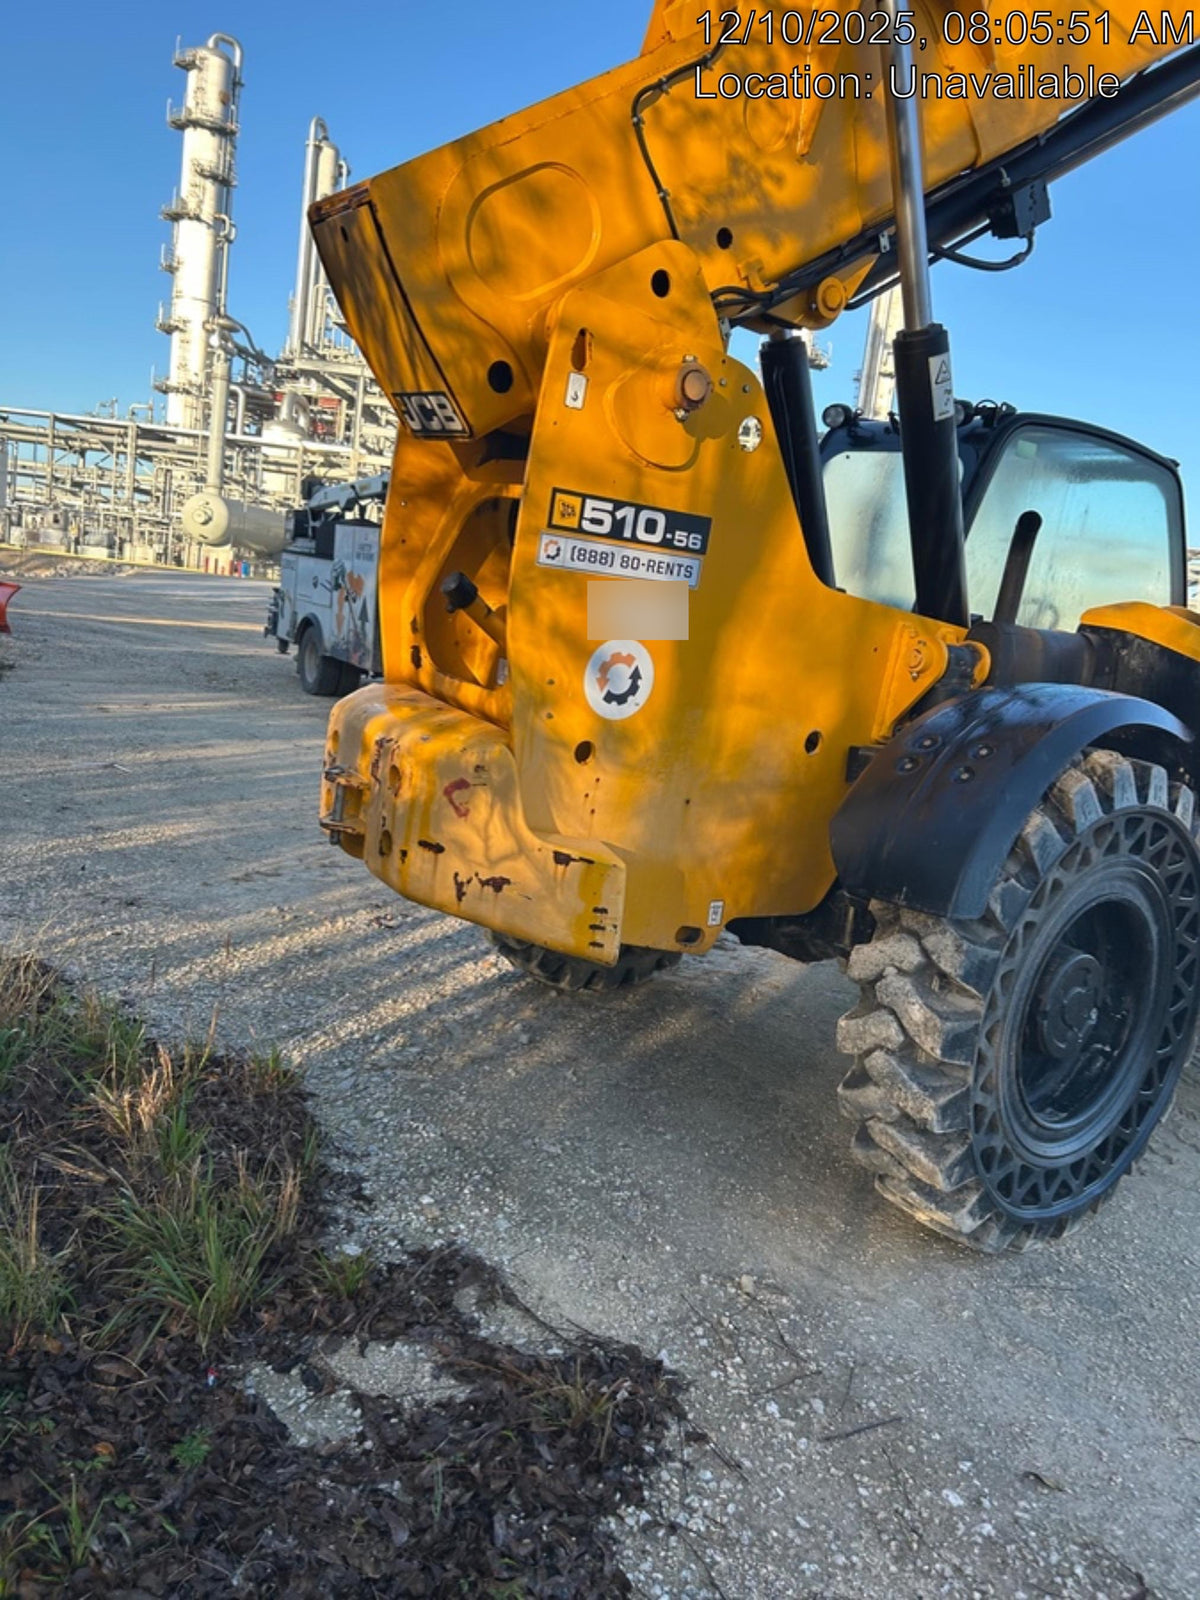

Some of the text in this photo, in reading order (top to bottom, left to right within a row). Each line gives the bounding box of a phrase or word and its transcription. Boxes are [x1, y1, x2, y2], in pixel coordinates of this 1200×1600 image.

[401, 395, 463, 431] JCB
[569, 544, 694, 579] (888) 80-RENTS
